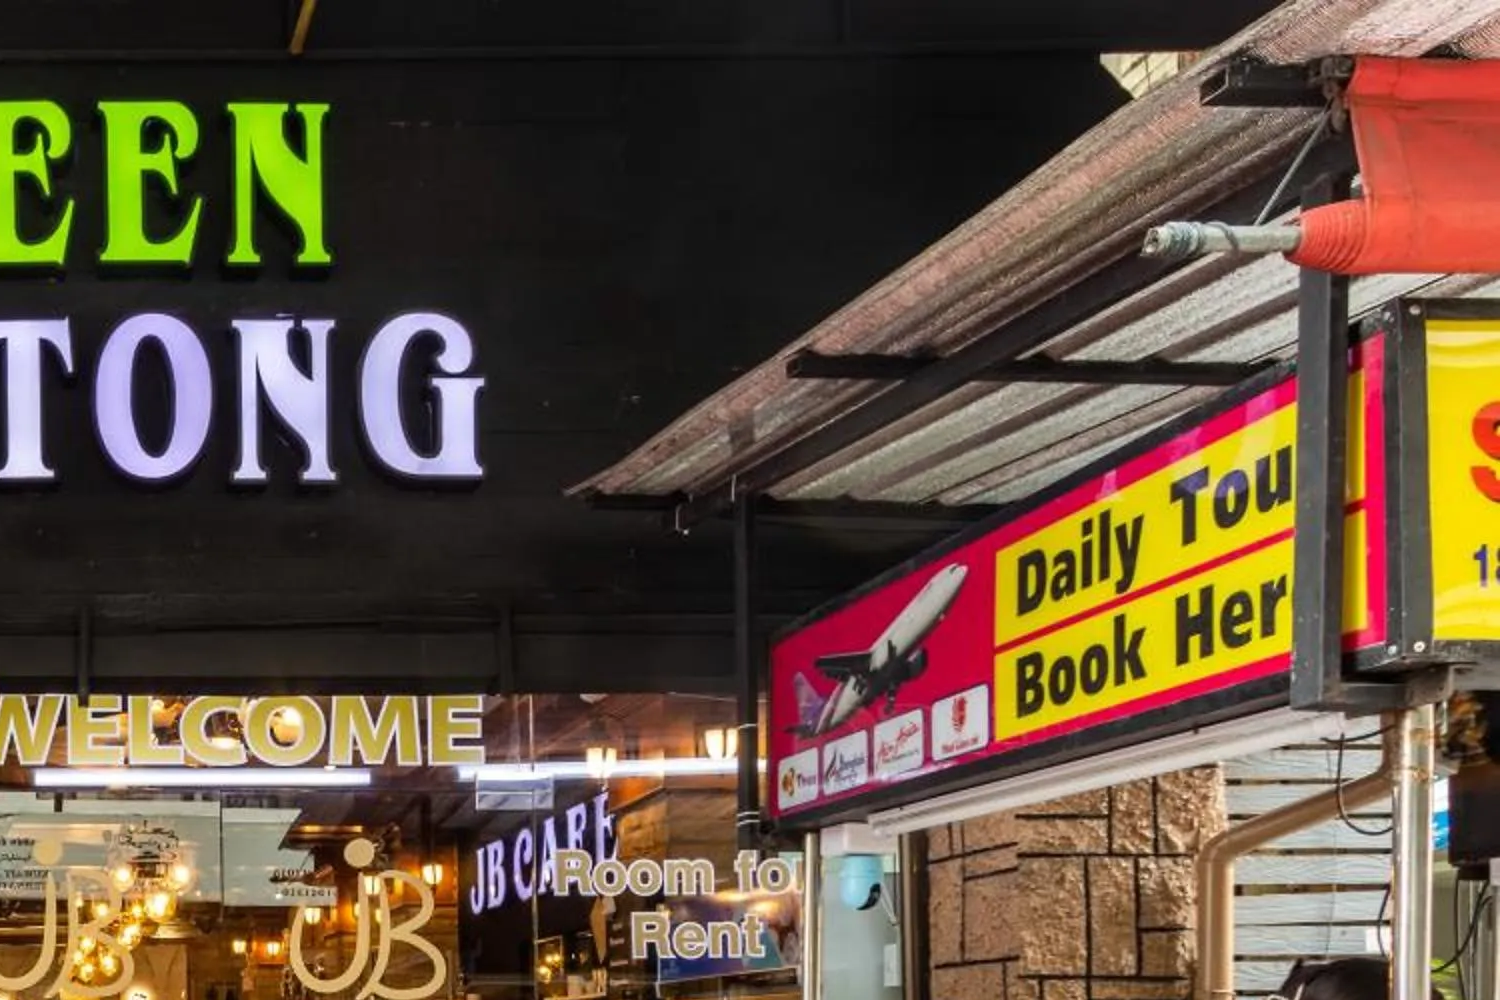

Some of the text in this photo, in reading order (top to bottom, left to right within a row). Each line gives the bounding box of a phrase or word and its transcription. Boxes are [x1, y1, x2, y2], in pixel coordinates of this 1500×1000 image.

[1016, 445, 1293, 617] Daily Tou
[1016, 573, 1288, 719] Book Her
[471, 839, 506, 914] JB
[553, 848, 715, 897] Room
[630, 911, 766, 960] Rent
